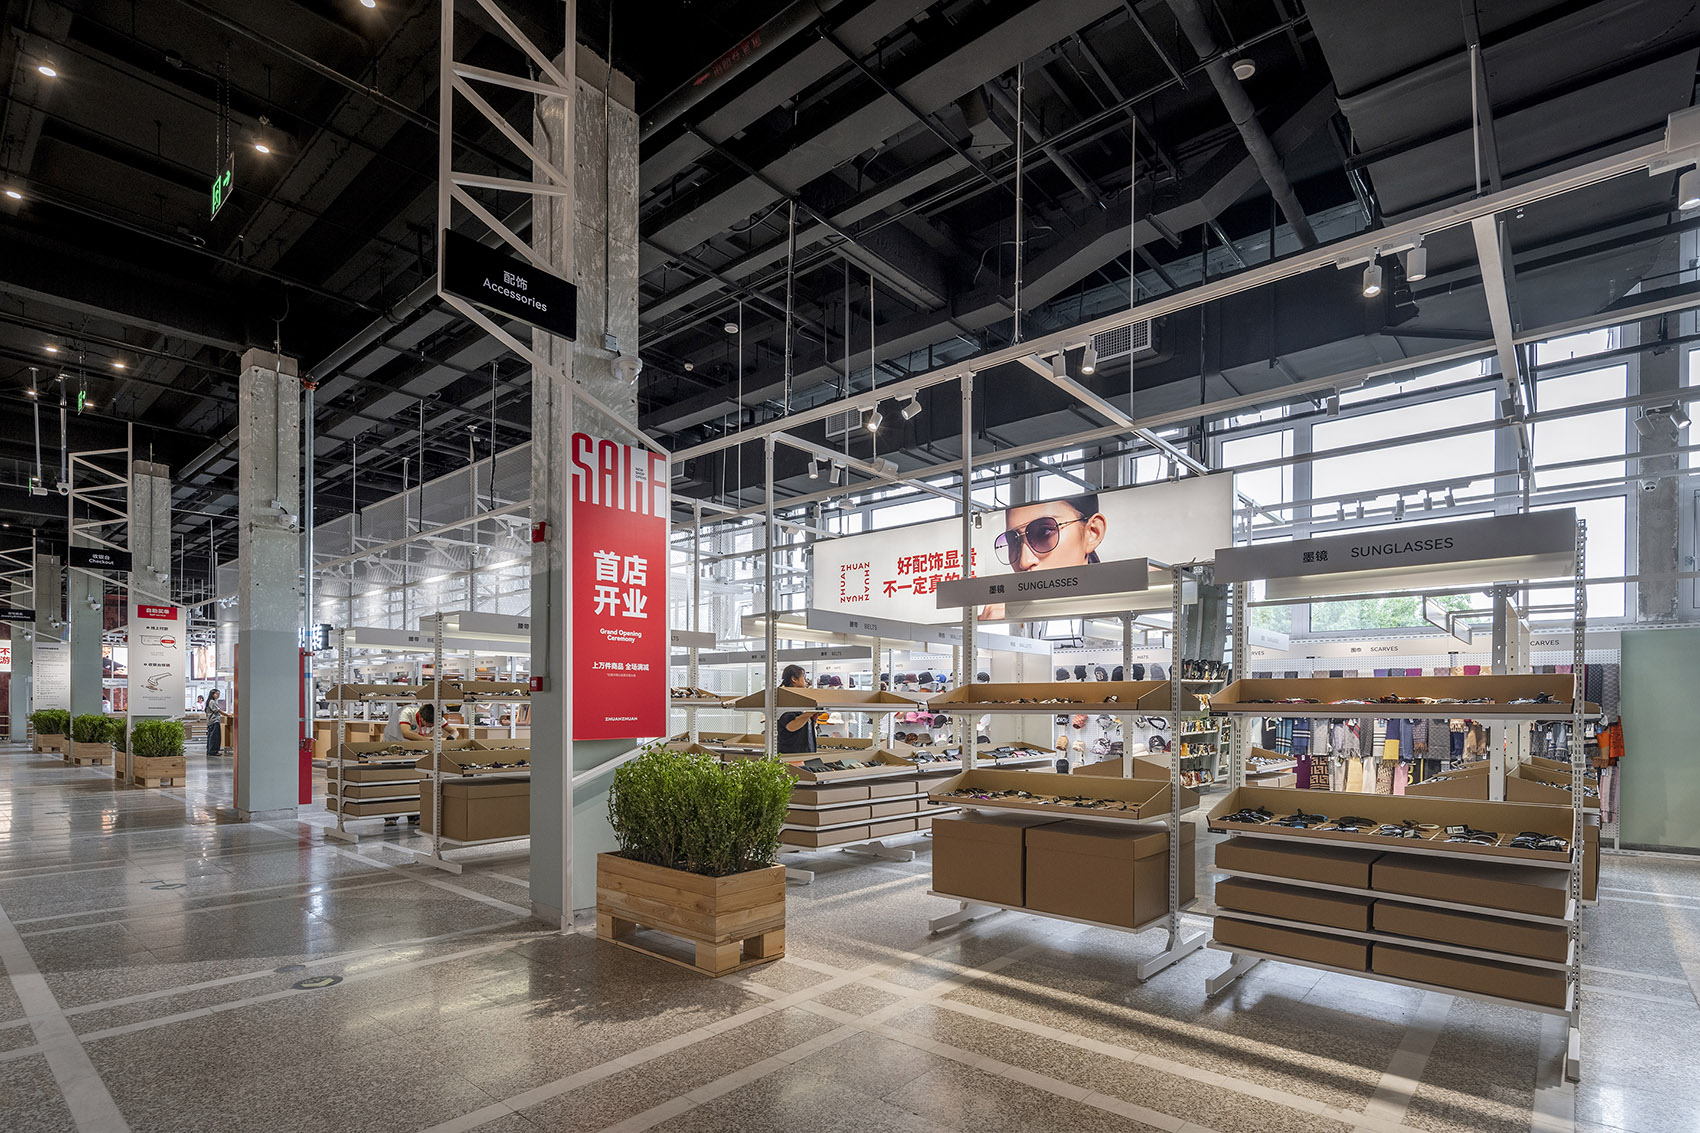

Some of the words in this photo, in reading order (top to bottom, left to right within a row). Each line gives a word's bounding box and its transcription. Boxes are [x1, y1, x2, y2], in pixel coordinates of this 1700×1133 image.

[503, 270, 528, 291] 配饰
[483, 278, 547, 312] Accessories
[1303, 550, 1329, 564] 墨镜
[1350, 537, 1454, 558] SUNGLASSES
[88, 558, 115, 566] Checkout
[840, 561, 870, 573] ZHUAN
[593, 550, 648, 586] 首店
[989, 585, 1005, 595] 墨镜
[1018, 577, 1079, 592] SUNGLASSES
[593, 585, 648, 618] 开业
[864, 623, 878, 631] BELTS
[600, 628, 618, 636] Grand
[618, 629, 642, 639] Opening
[607, 635, 636, 644] Ceremony
[1530, 639, 1560, 647] CARVES
[1370, 645, 1399, 653] SCARVES
[592, 661, 624, 671] 上万件商品
